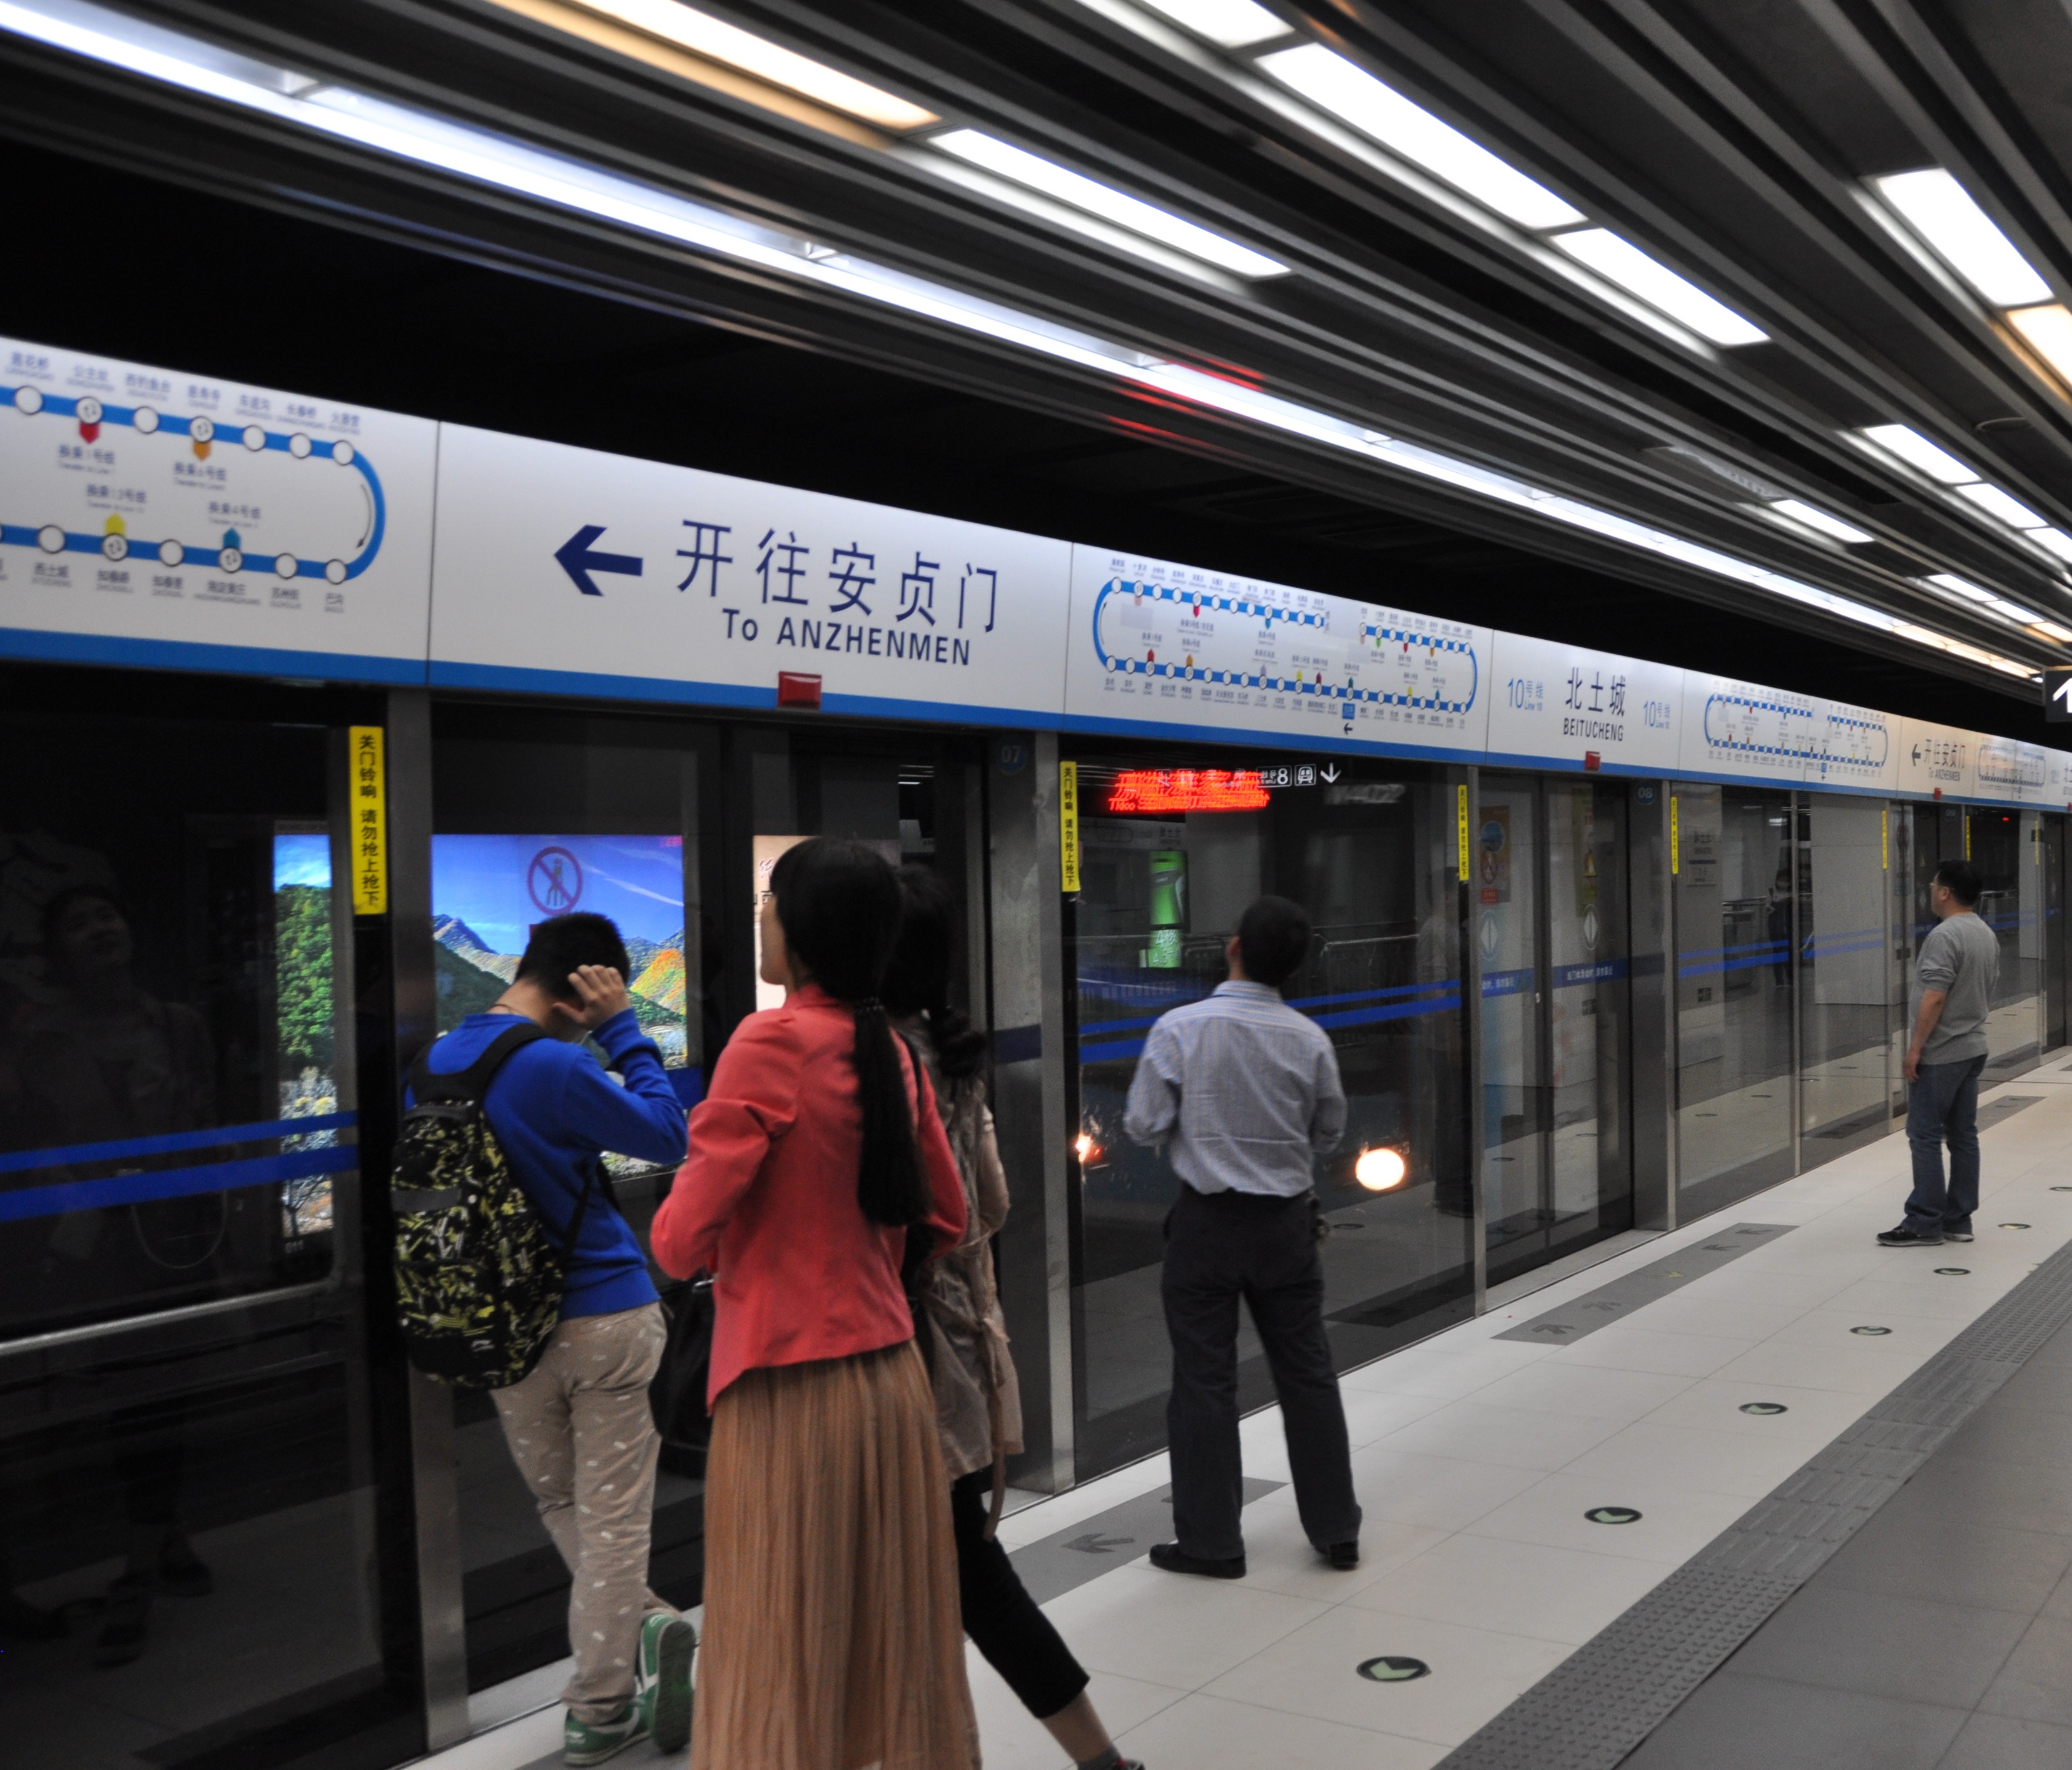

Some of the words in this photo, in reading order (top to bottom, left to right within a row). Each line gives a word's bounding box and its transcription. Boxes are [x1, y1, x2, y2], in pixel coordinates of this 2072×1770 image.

[676, 518, 998, 634] 开往安贞门
[722, 608, 758, 641] To
[777, 616, 971, 666] ANZHENMEN
[1565, 667, 1626, 717] 北土城
[1563, 717, 1623, 742] BEITUCHENG
[359, 735, 377, 799] 关门铃响
[1638, 787, 1653, 798] 08
[360, 809, 378, 906] 请勿抢上抢下
